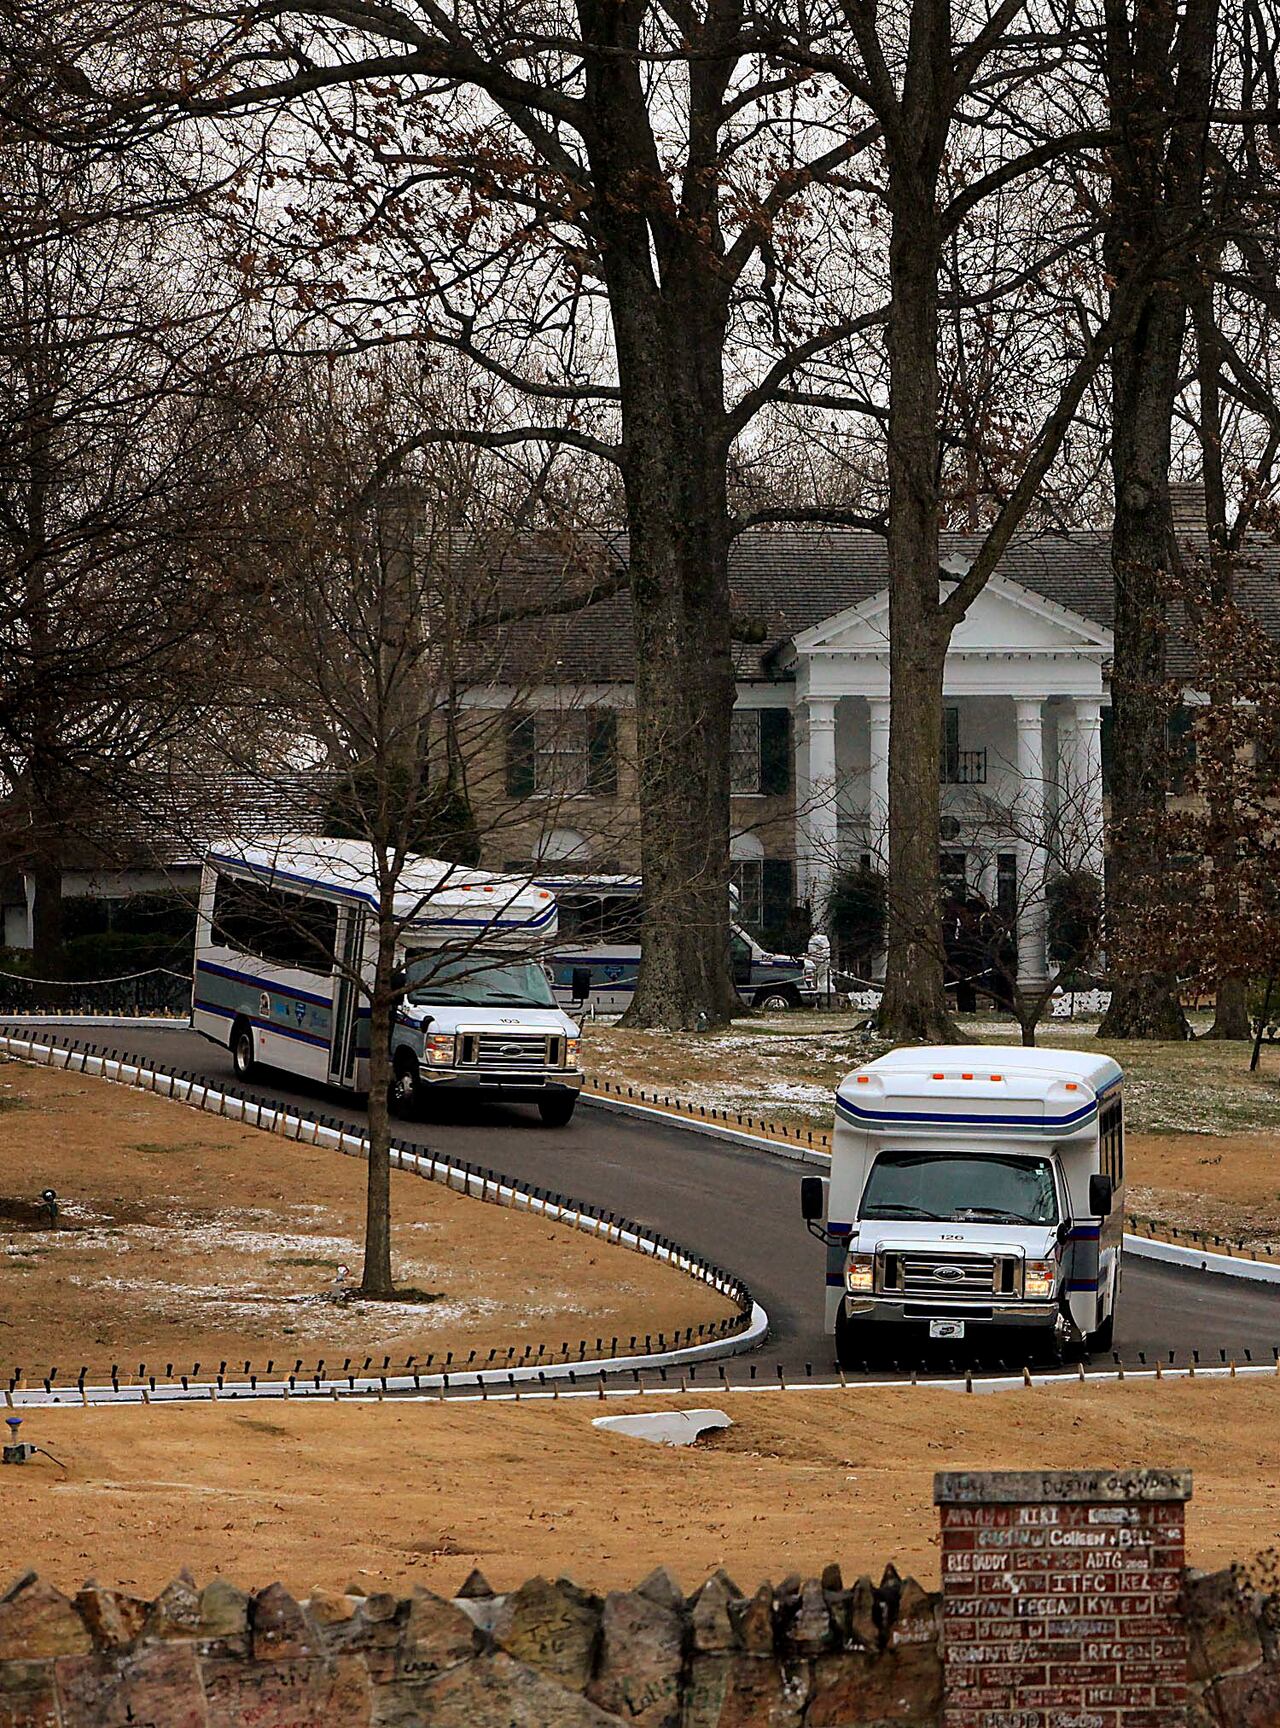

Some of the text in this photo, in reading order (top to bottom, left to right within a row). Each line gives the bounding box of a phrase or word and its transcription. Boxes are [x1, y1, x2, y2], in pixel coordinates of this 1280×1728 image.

[947, 1554, 970, 1572] BIG
[972, 1554, 1008, 1571] DADDY
[1086, 1552, 1122, 1569] ADTG
[1052, 1574, 1106, 1593] ITFC
[1088, 1597, 1130, 1616] KYLE
